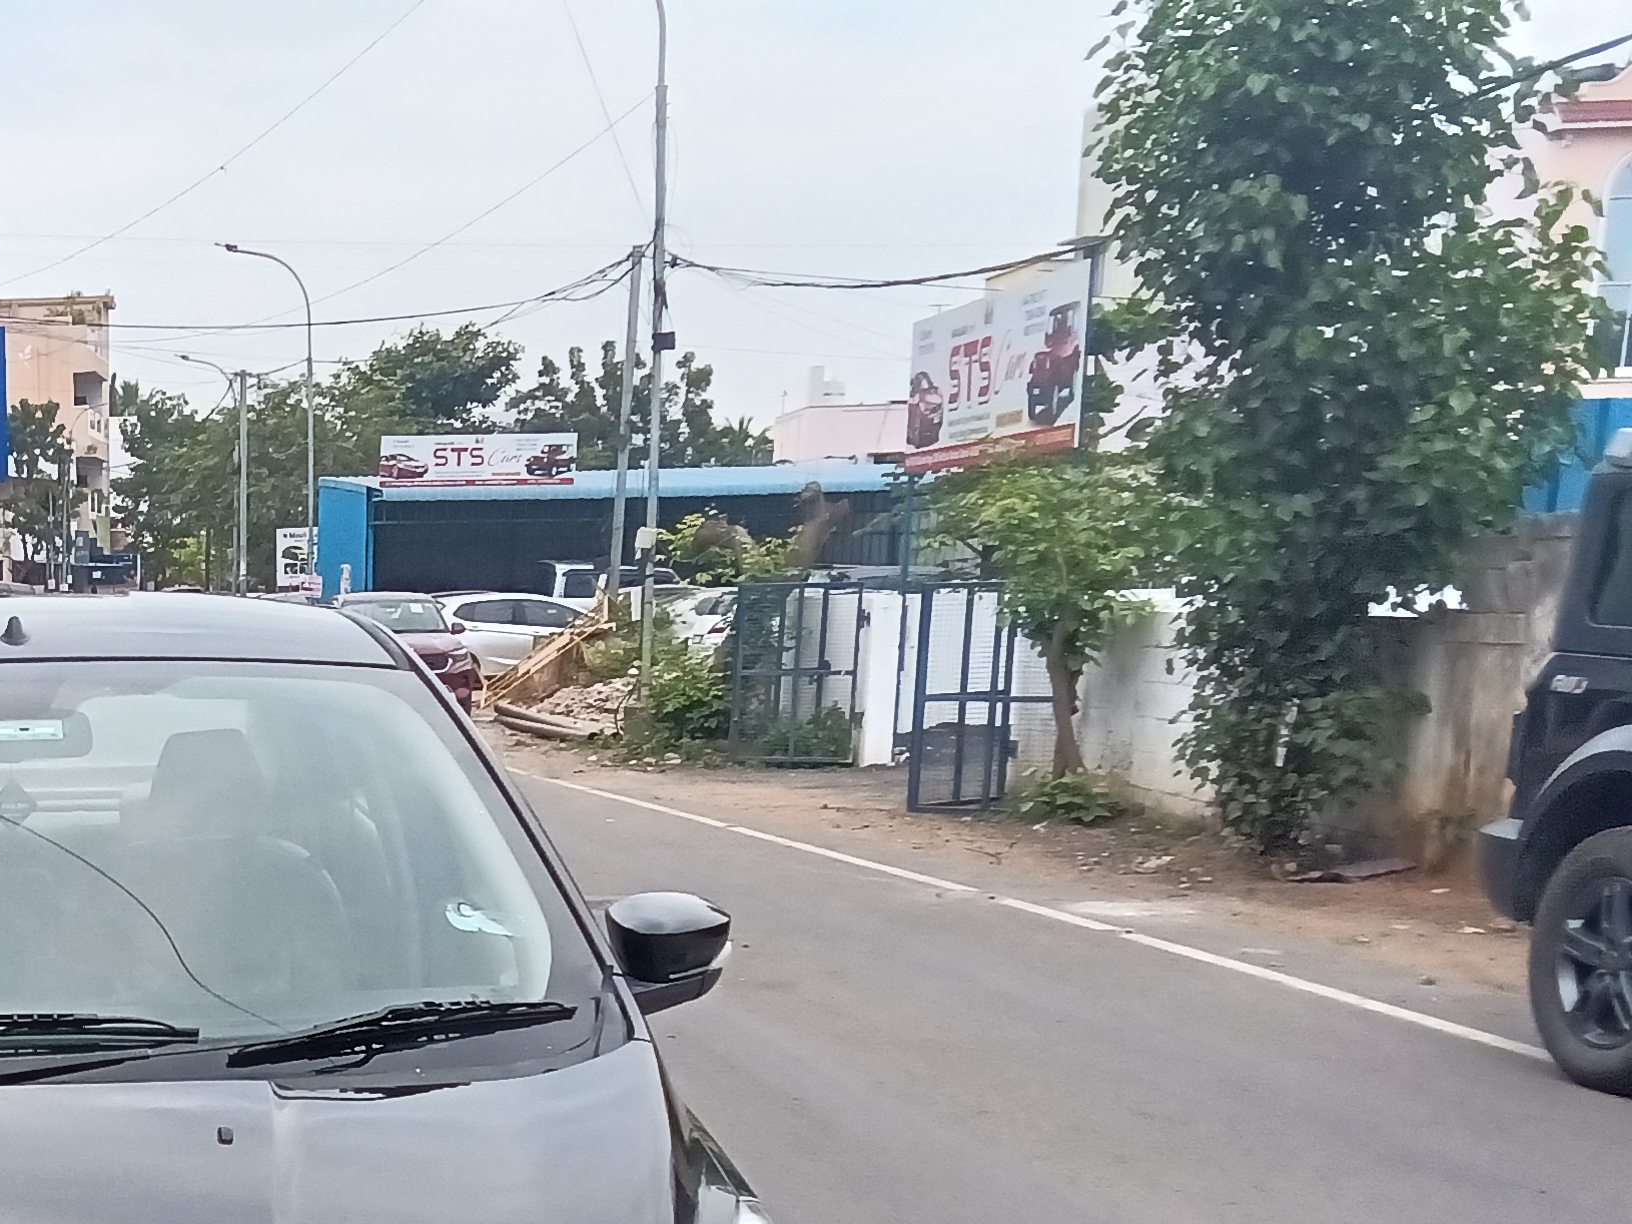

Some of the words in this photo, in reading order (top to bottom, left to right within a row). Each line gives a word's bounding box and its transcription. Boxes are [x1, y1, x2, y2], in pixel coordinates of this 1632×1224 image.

[948, 335, 992, 412] STS
[433, 447, 484, 467] STS
[487, 447, 524, 467] Cars
